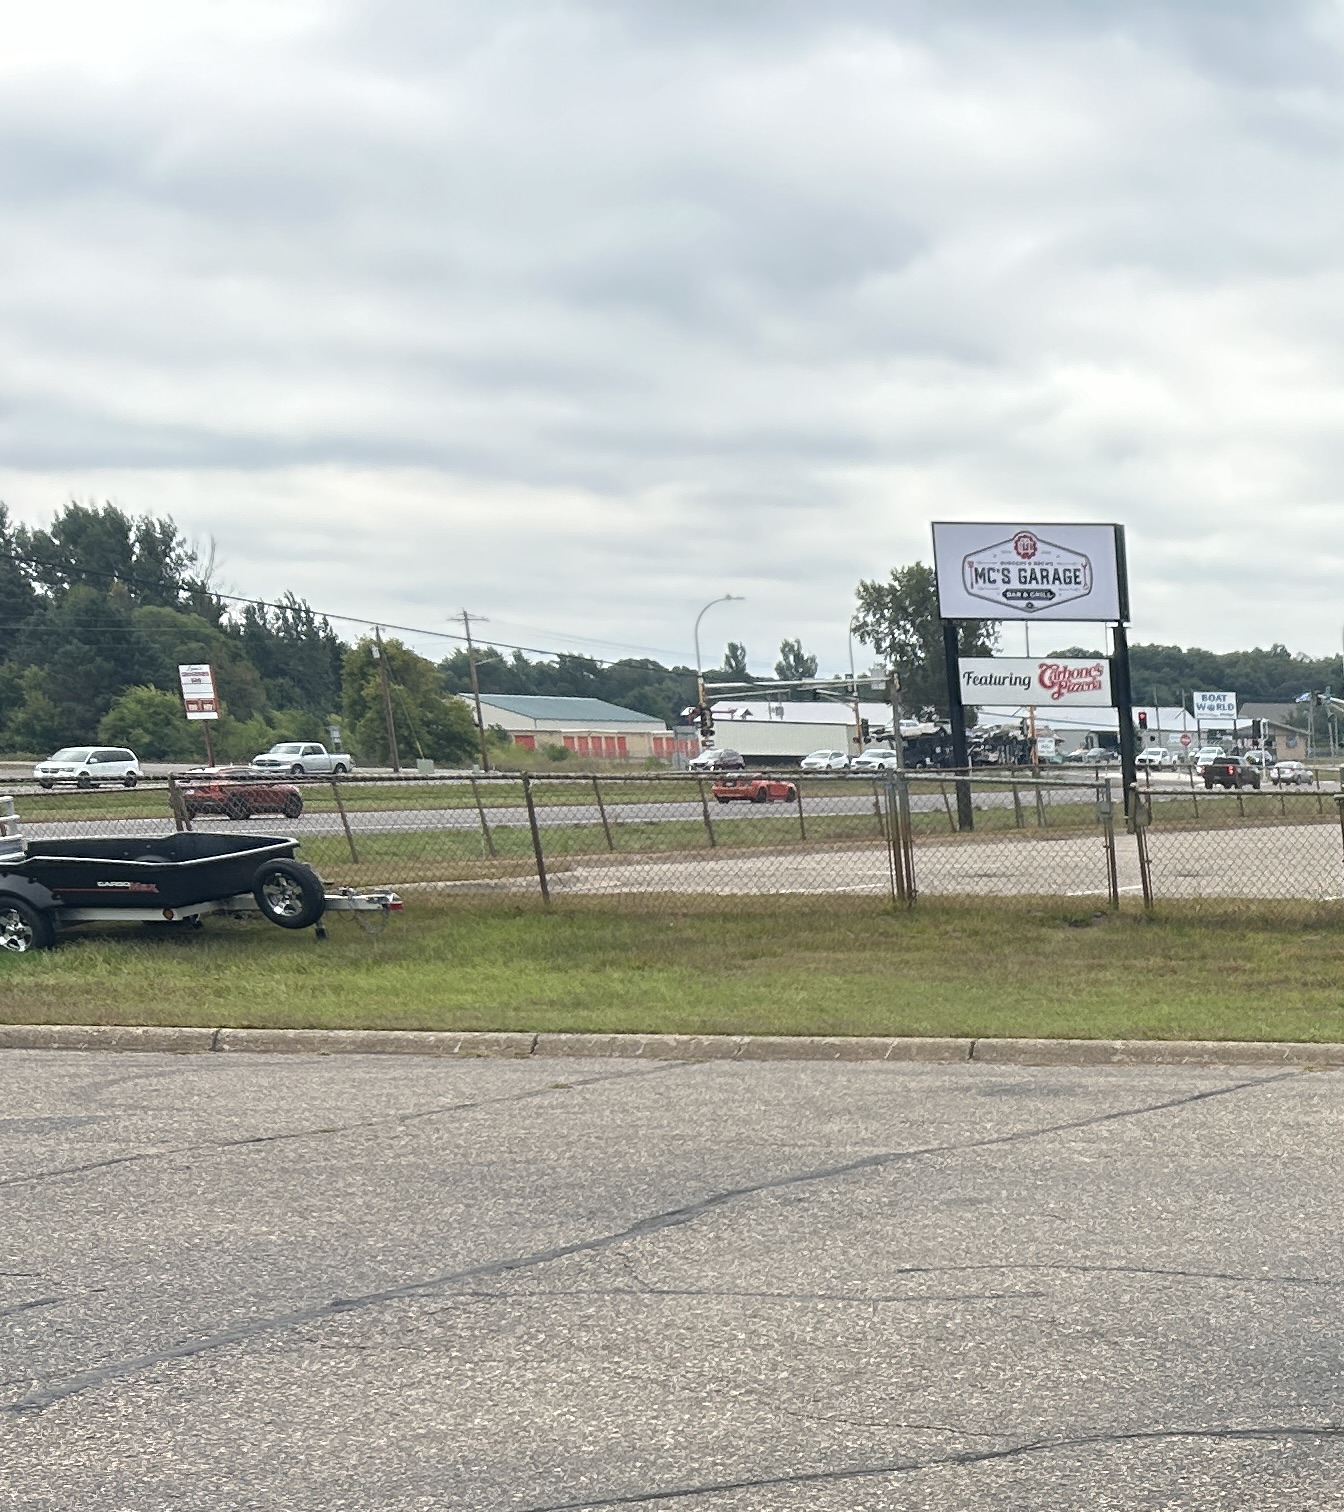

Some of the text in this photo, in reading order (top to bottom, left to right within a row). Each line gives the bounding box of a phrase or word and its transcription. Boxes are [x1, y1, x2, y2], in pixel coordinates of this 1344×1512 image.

[974, 566, 1082, 586] MC'S GARAGE
[962, 671, 1032, 691] Featuring
[1201, 694, 1228, 702] BOAT
[1196, 702, 1235, 711] WORLD
